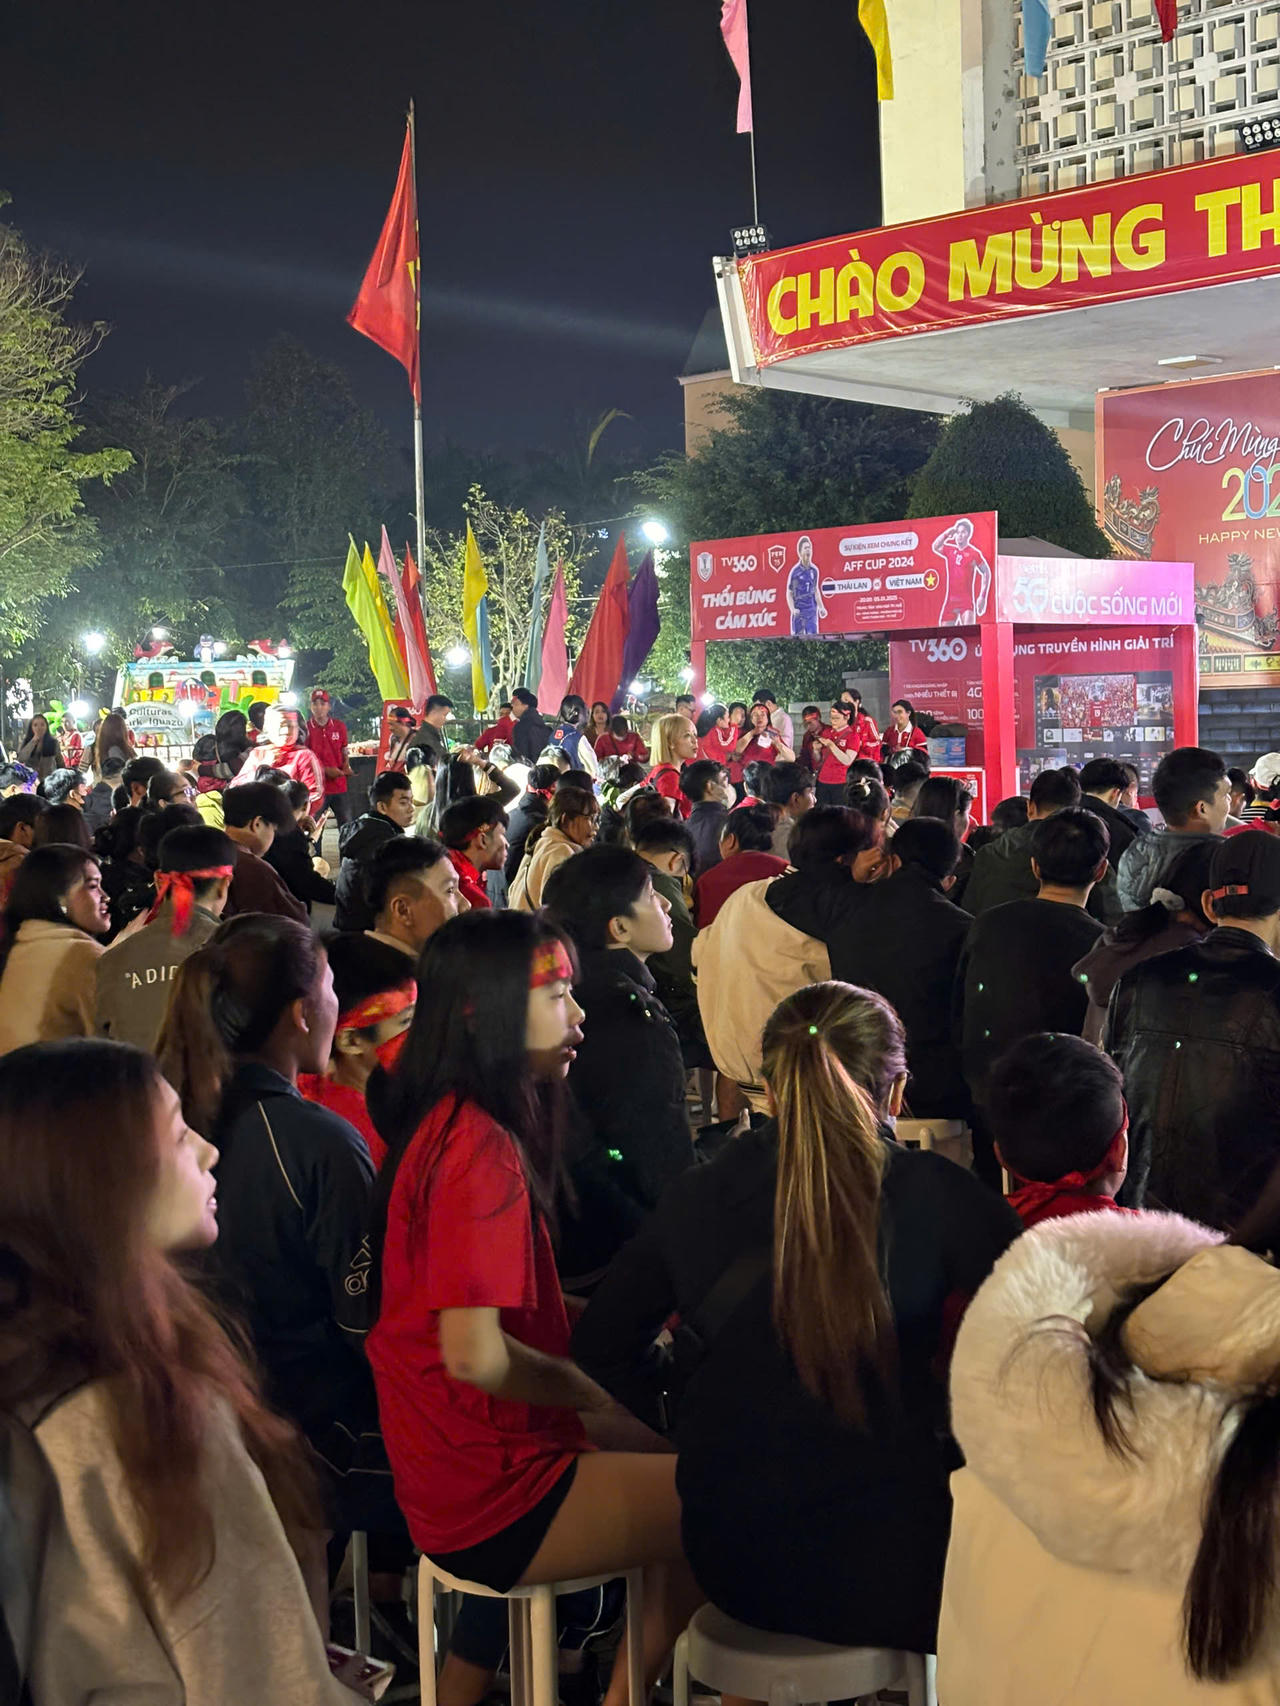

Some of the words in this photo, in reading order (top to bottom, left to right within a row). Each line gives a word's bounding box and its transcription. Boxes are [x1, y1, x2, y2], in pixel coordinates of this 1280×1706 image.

[767, 248, 926, 336] CHÀO
[948, 202, 1166, 302] MỪNG
[1194, 178, 1280, 258] TH
[1145, 417, 1225, 471] Chúc
[1198, 529, 1250, 544] HAPPY
[1254, 527, 1280, 540] NE
[721, 554, 758, 573] TV360
[843, 560, 864, 572] AFF
[865, 558, 886, 570] CUP
[888, 556, 915, 568] 2024
[837, 581, 853, 590] THÁI
[854, 581, 868, 589] LAN
[889, 577, 905, 587] VIỆT
[905, 577, 922, 586] NAM
[701, 584, 734, 608] THỔI
[1051, 591, 1098, 618] CUỘC
[1100, 586, 1148, 616] SỐNG
[1151, 591, 1183, 616] MỚI
[747, 608, 778, 628] XÚC
[908, 637, 968, 663] TV360
[1038, 636, 1088, 655] TRUYỀN
[1090, 637, 1121, 652] HÌNH
[1124, 635, 1149, 650] GIẢI
[1152, 632, 1174, 649] TRÍ
[966, 687, 982, 698] 4G
